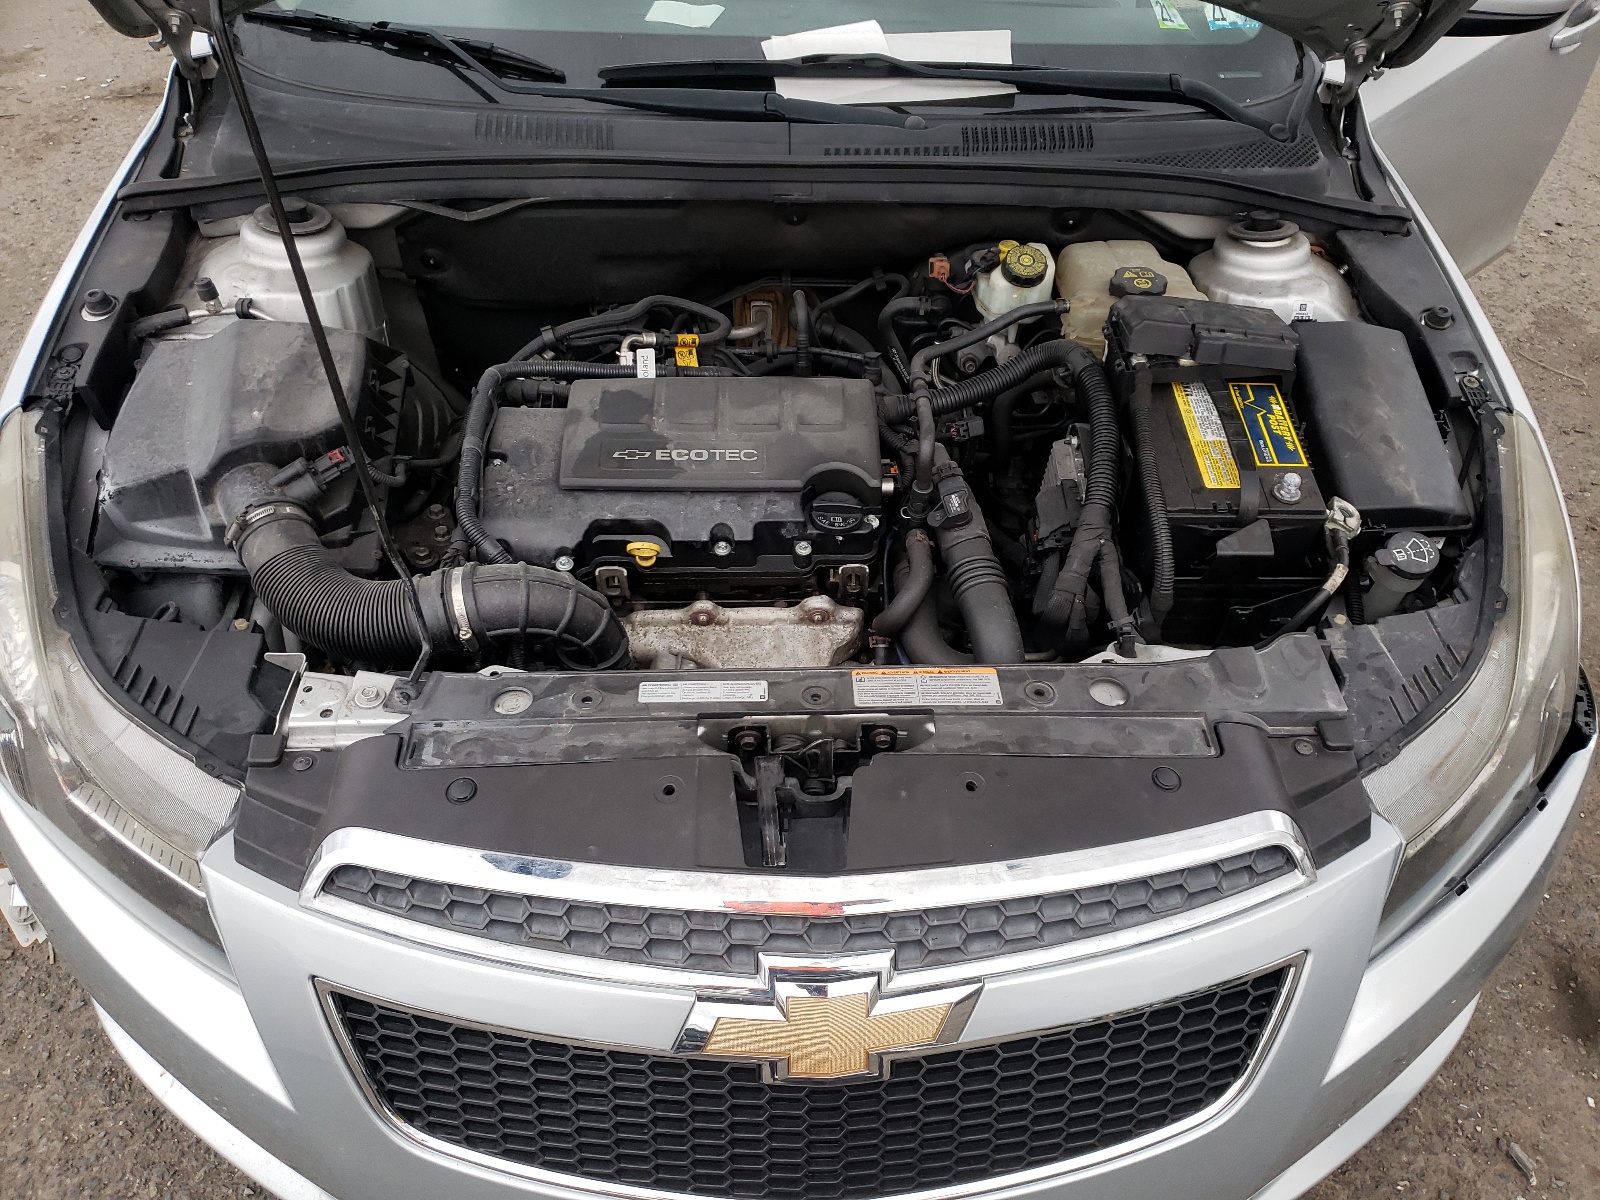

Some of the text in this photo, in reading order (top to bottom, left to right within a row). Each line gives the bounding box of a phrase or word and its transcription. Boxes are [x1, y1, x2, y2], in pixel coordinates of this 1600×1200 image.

[1267, 413, 1283, 436] POST
[1273, 409, 1294, 443] BATTERY
[656, 449, 758, 461] ECOTEC
